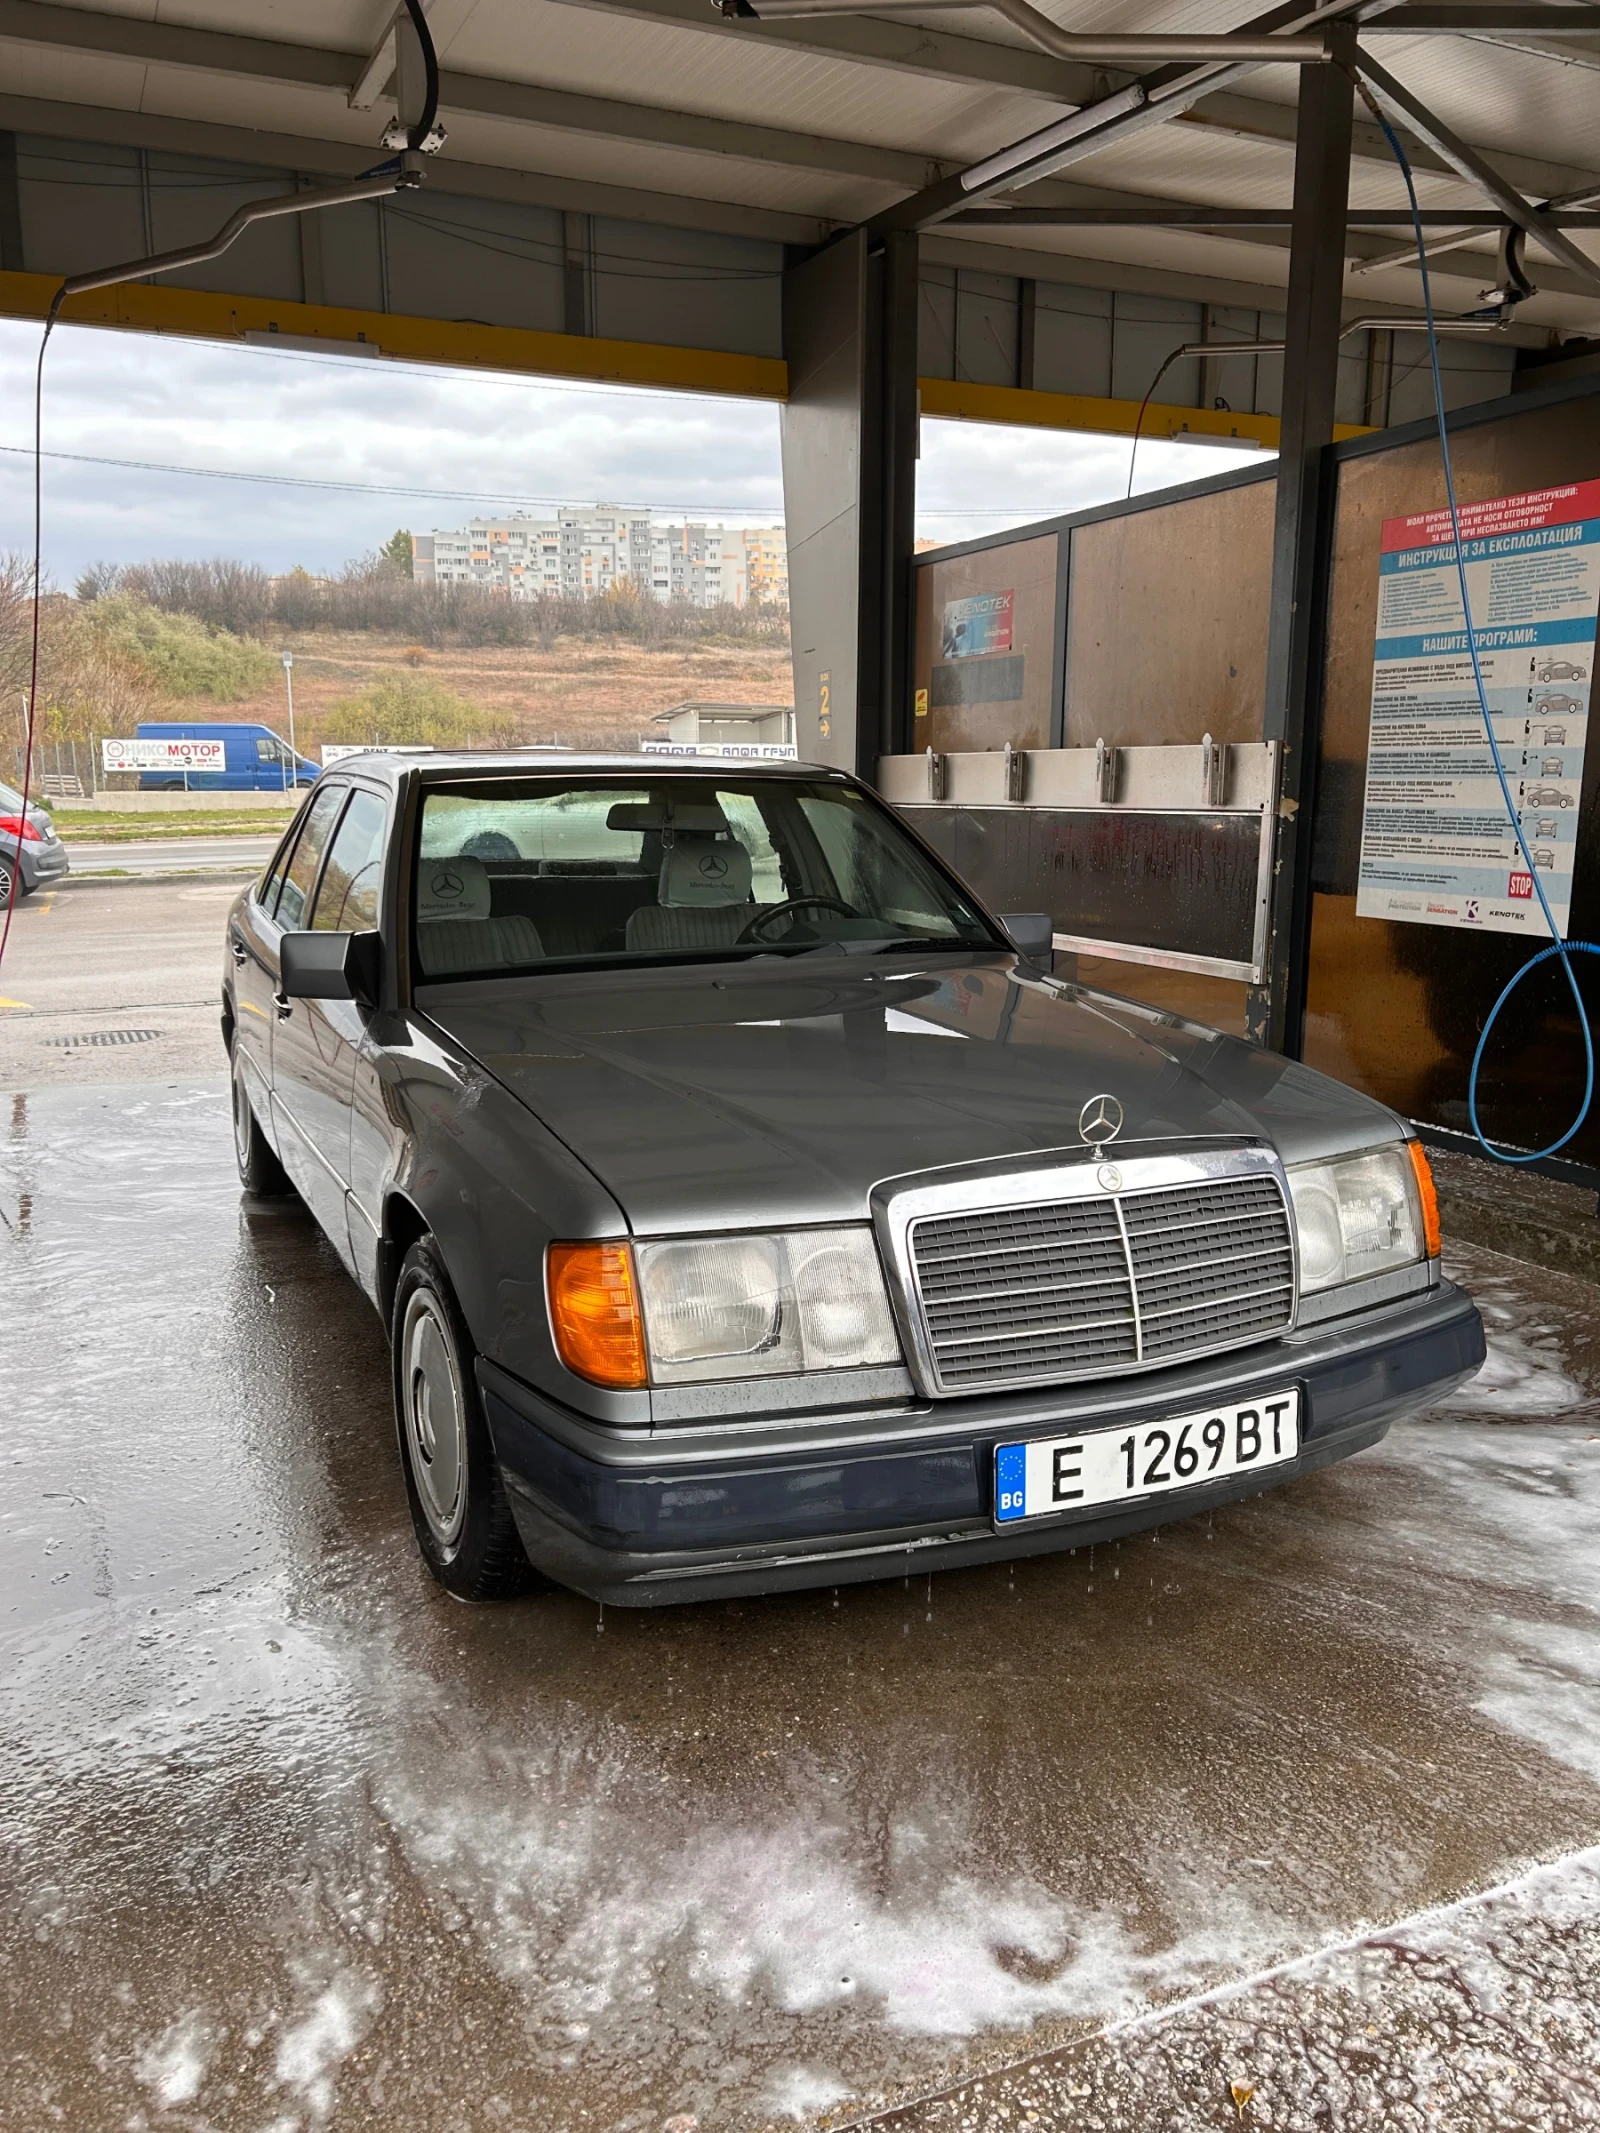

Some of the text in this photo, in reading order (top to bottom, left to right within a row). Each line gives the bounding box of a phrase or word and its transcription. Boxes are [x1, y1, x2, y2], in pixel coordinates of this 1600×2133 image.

[1406, 487, 1578, 526] МОЛЯ ПРОЧЕТЕЕ ВНИМАТЕЛНО ТЕЗИ ИНСТРУКЦИИ:
[1426, 502, 1553, 533] АВТОМИКАТА НЕ НОСИ ОТГОВОРНОСТ
[1431, 516, 1545, 542] ЗА ЩЕТ ПРИ НЕСПАЗВАНЕТО ИМ!
[1398, 526, 1583, 568] ИНСТРУКЦИЯ ЗА ЕКСПЛОАТАЦИЯ
[1422, 634, 1468, 652] НАШИТЕ
[820, 685, 830, 714] 2
[125, 744, 221, 757] НИКОМОТОР
[1510, 876, 1532, 896] STOP
[1052, 1444, 1084, 1502] E
[1000, 1490, 1023, 1510] BG
